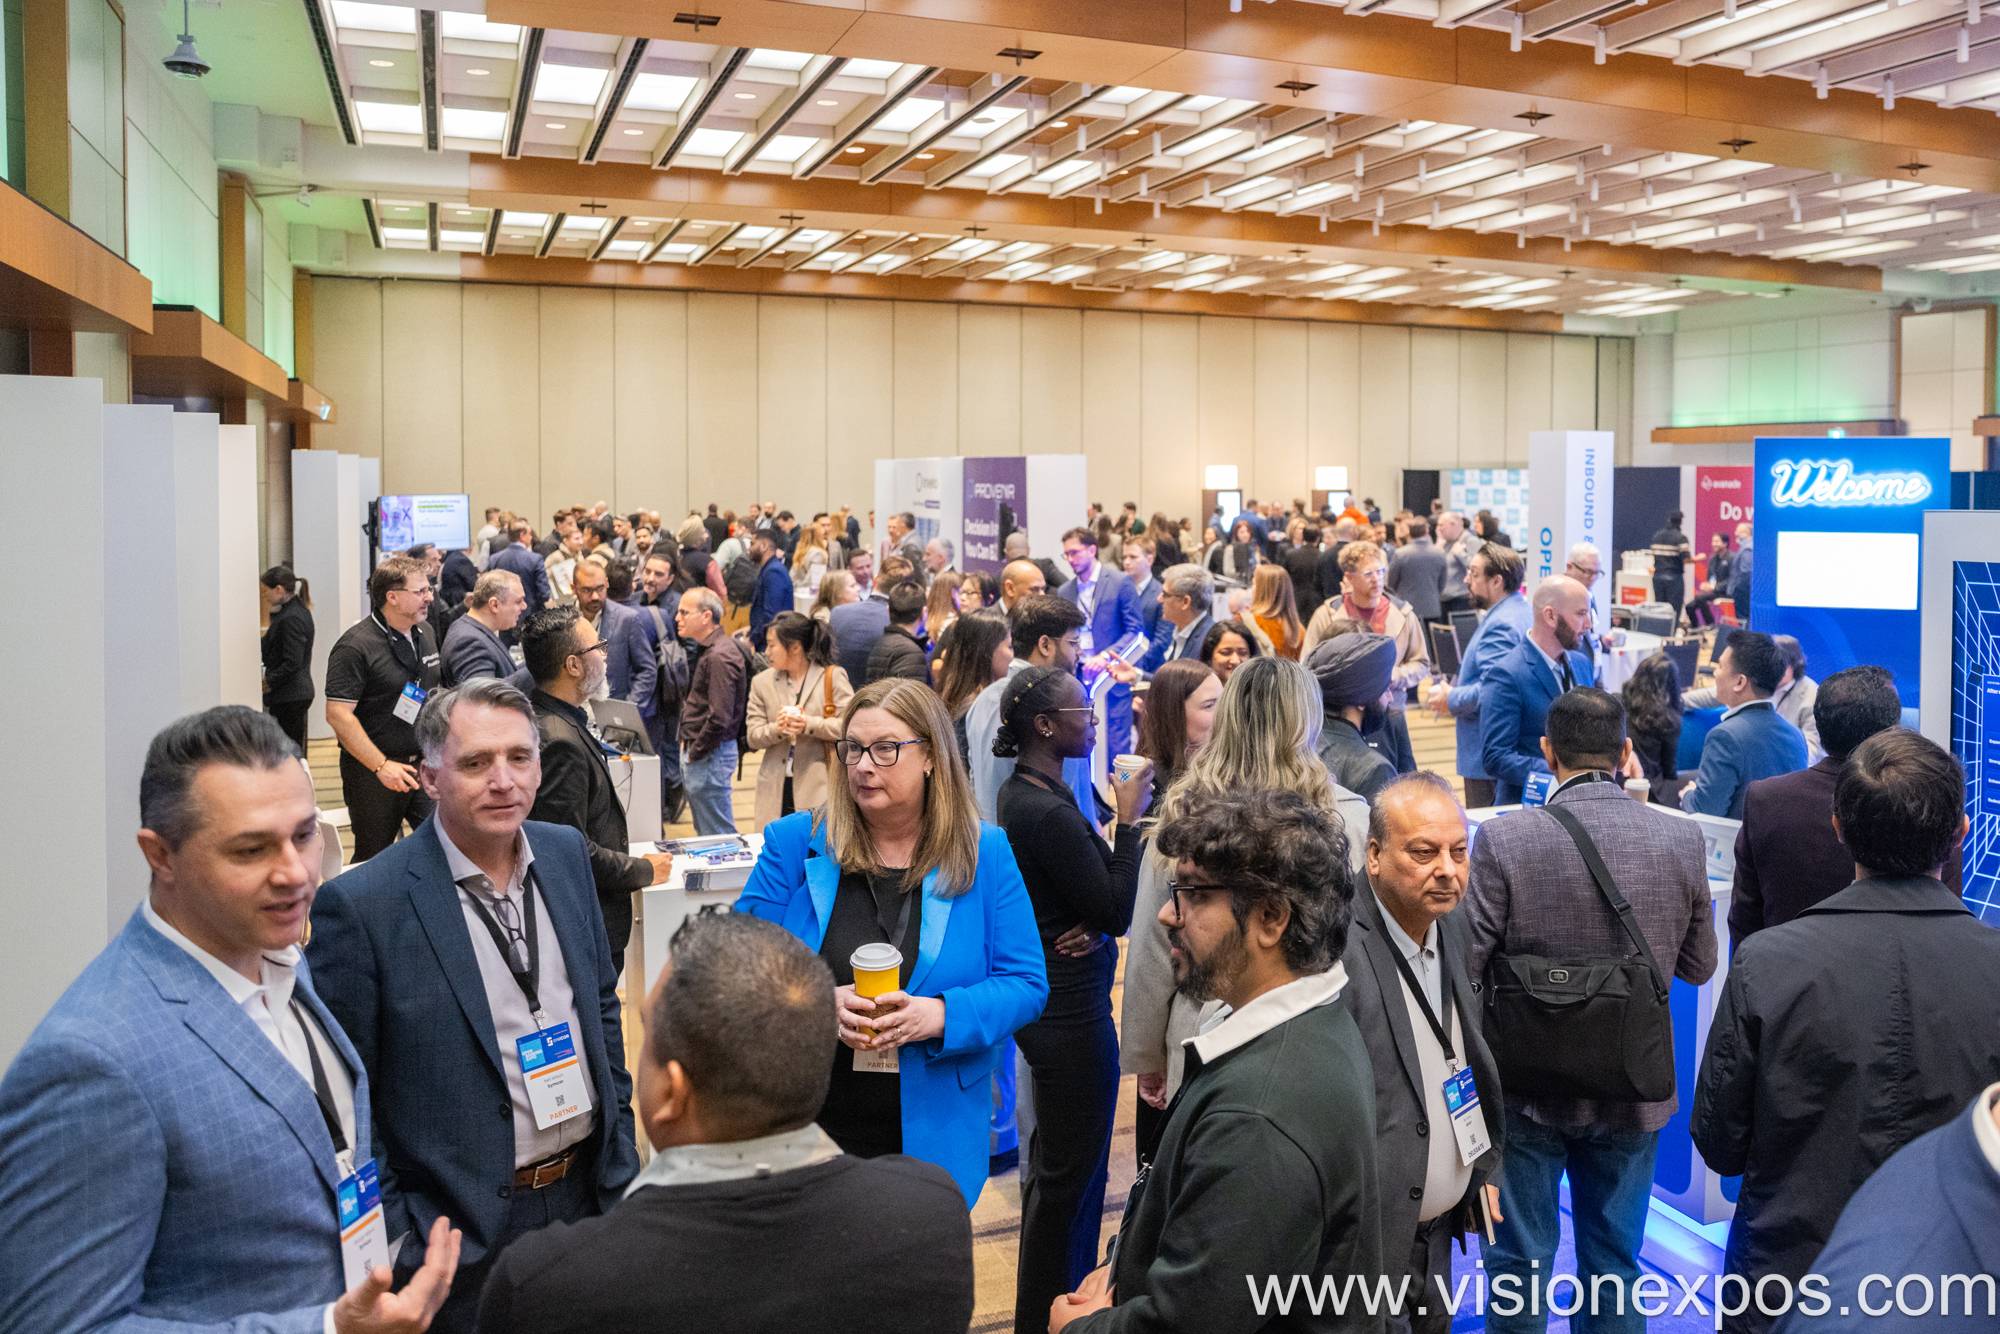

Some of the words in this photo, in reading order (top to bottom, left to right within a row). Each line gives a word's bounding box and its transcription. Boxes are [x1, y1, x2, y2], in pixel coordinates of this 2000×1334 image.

[1584, 448, 1595, 529] INBOUND
[1773, 460, 1931, 505] Welcome
[1720, 501, 1742, 521] Do
[1539, 527, 1553, 578] OPE
[867, 1061, 898, 1069] PARTNER
[549, 1105, 578, 1120] PARTNER
